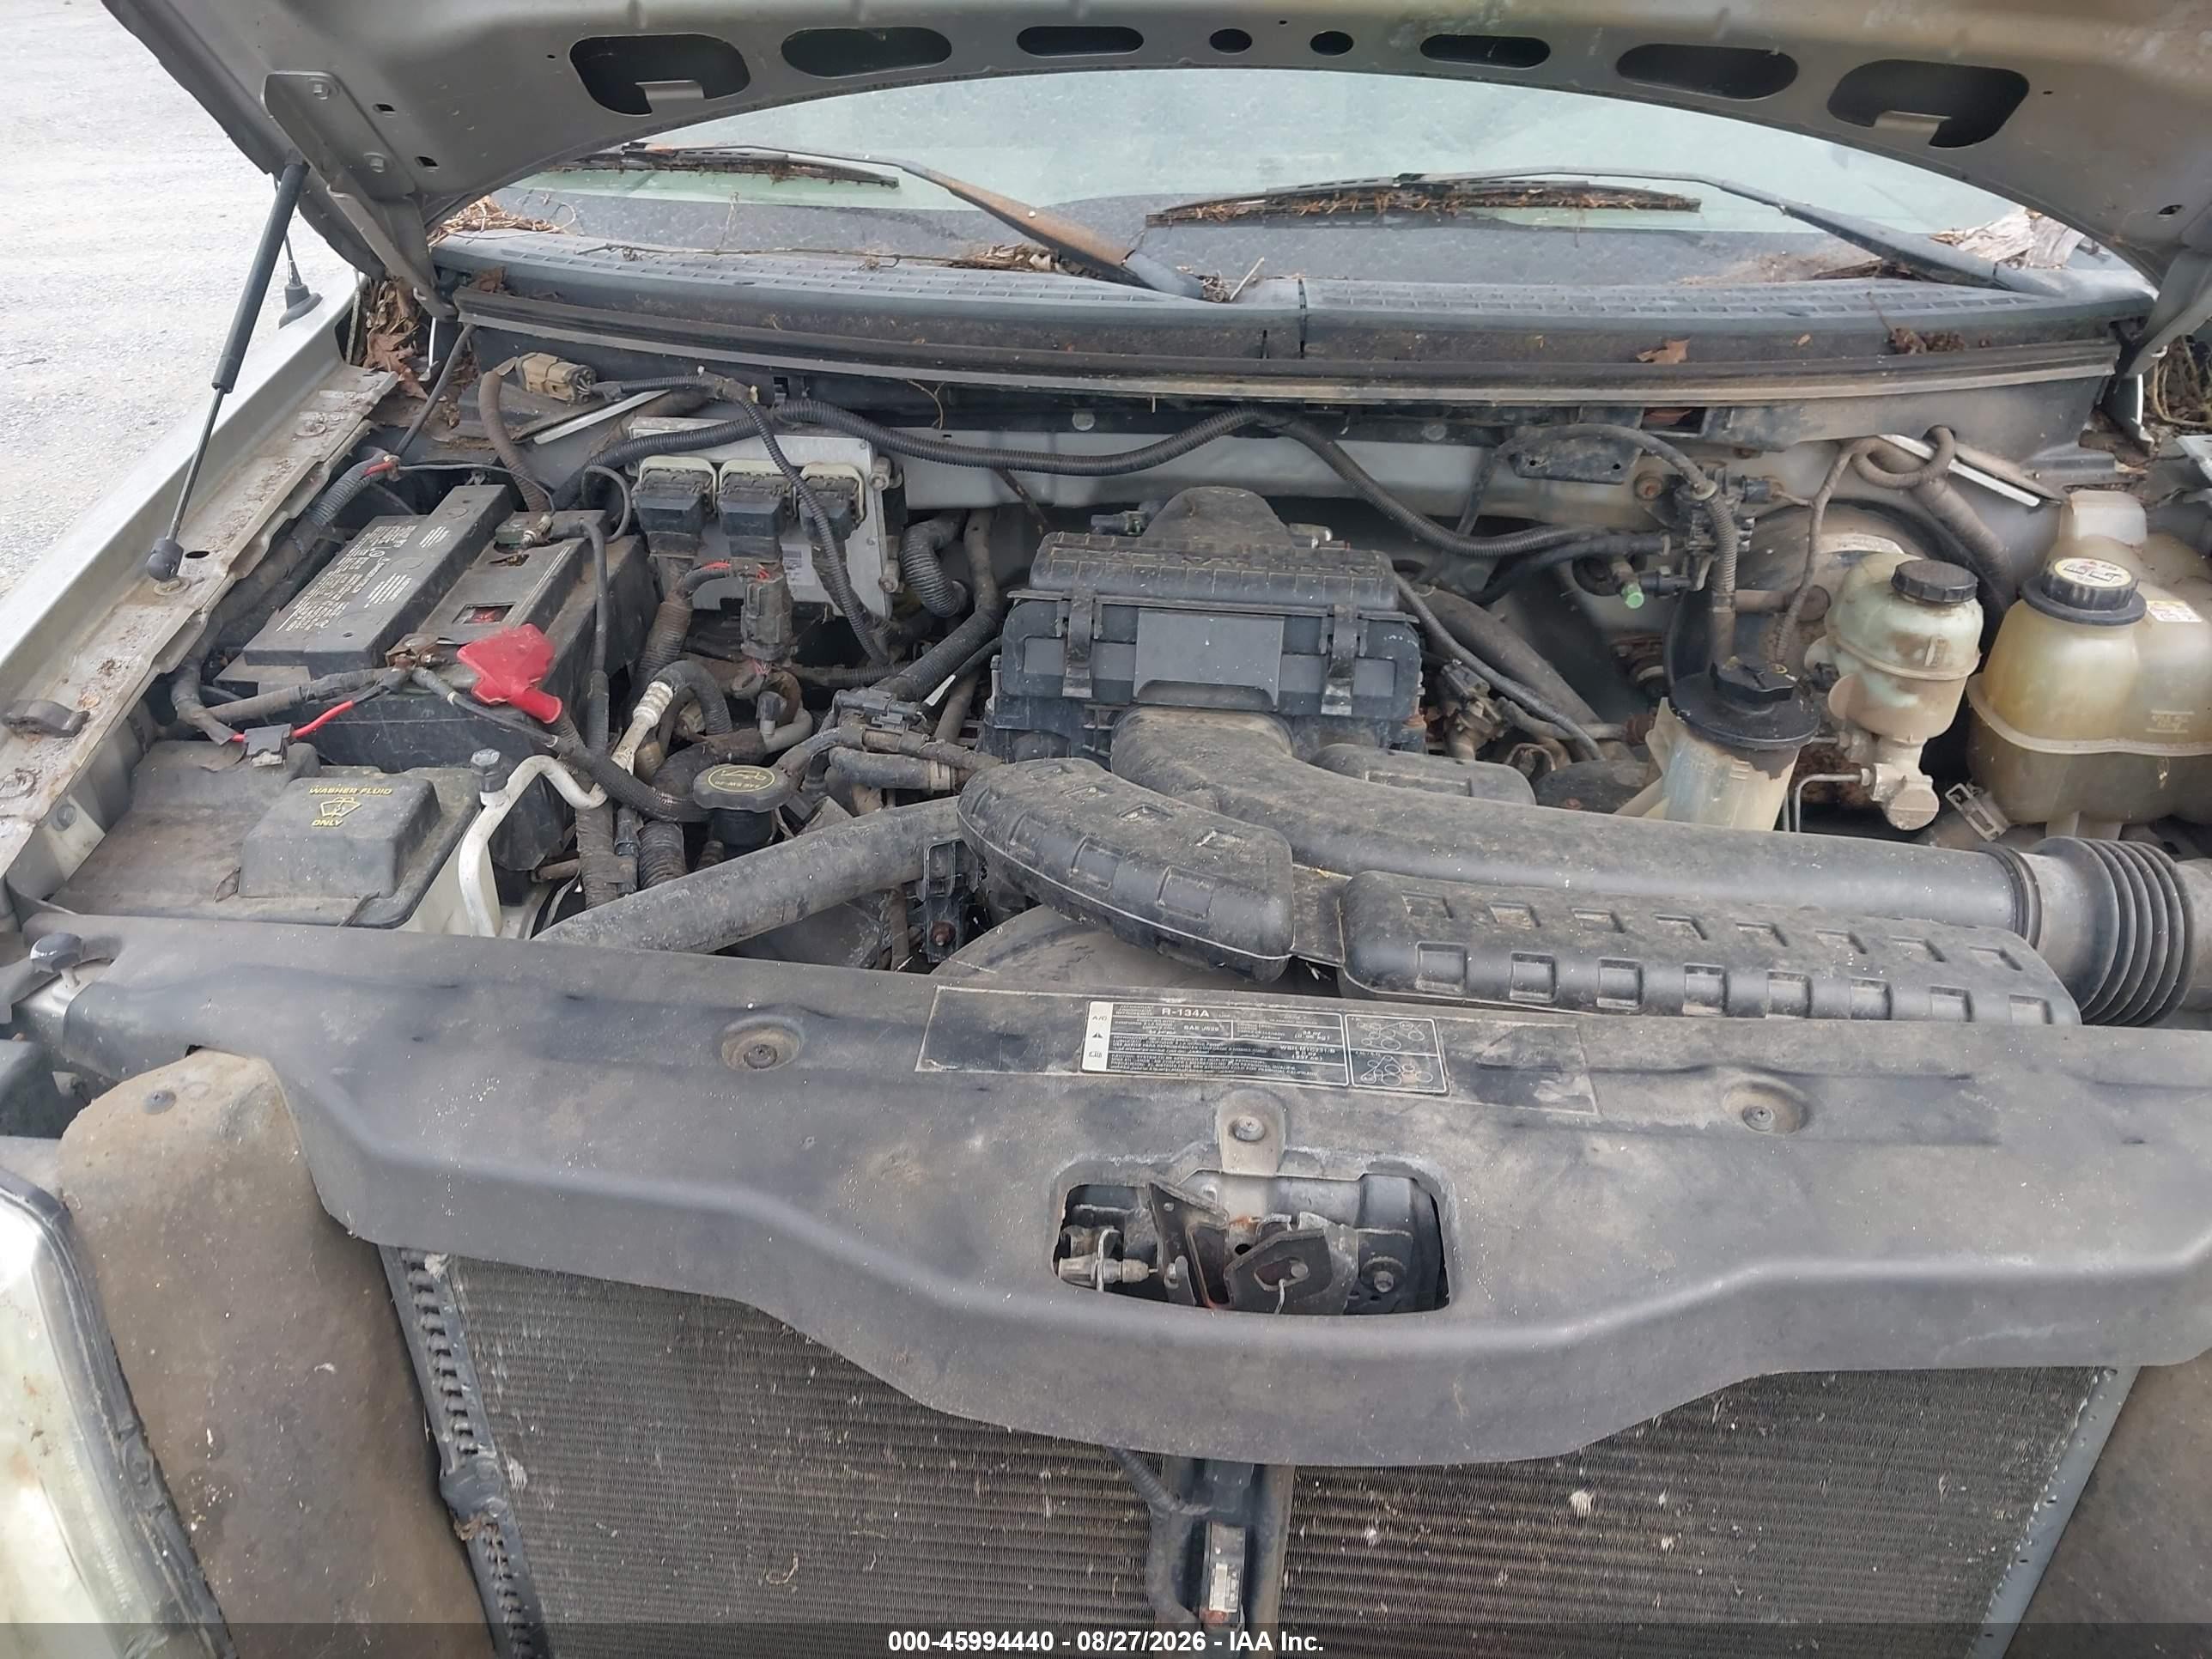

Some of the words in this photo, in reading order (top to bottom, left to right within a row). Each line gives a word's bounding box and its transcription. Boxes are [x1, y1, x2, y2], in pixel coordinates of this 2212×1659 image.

[309, 787, 358, 795] WASHER
[359, 787, 393, 796] FLUID
[1161, 1007, 1210, 1018] R-134A
